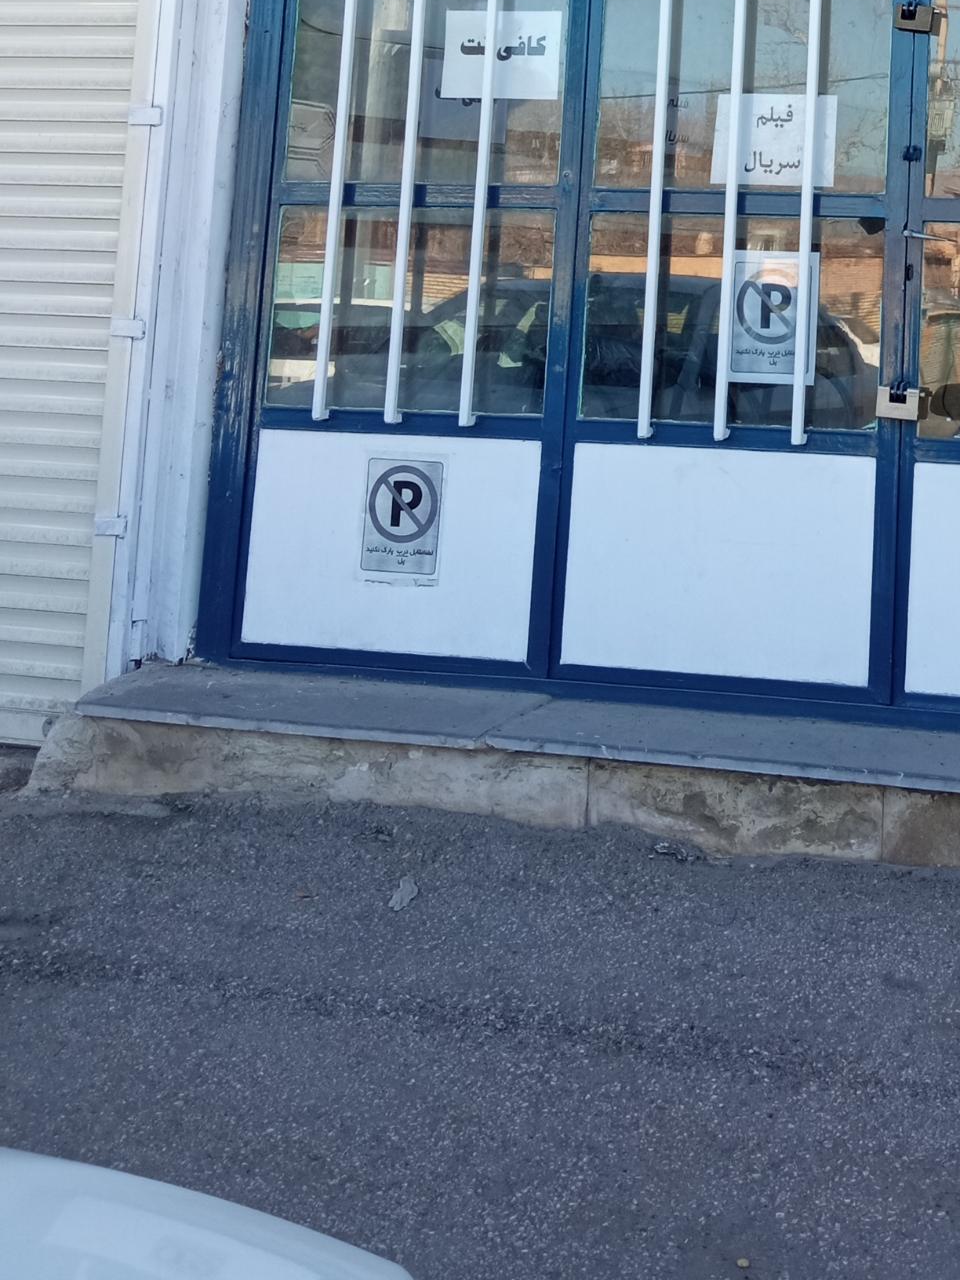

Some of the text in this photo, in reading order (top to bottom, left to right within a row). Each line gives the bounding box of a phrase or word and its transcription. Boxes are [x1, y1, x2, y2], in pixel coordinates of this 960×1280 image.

[496, 35, 546, 61] کافی
[756, 104, 794, 129] فیلم
[744, 150, 801, 175] سریال
